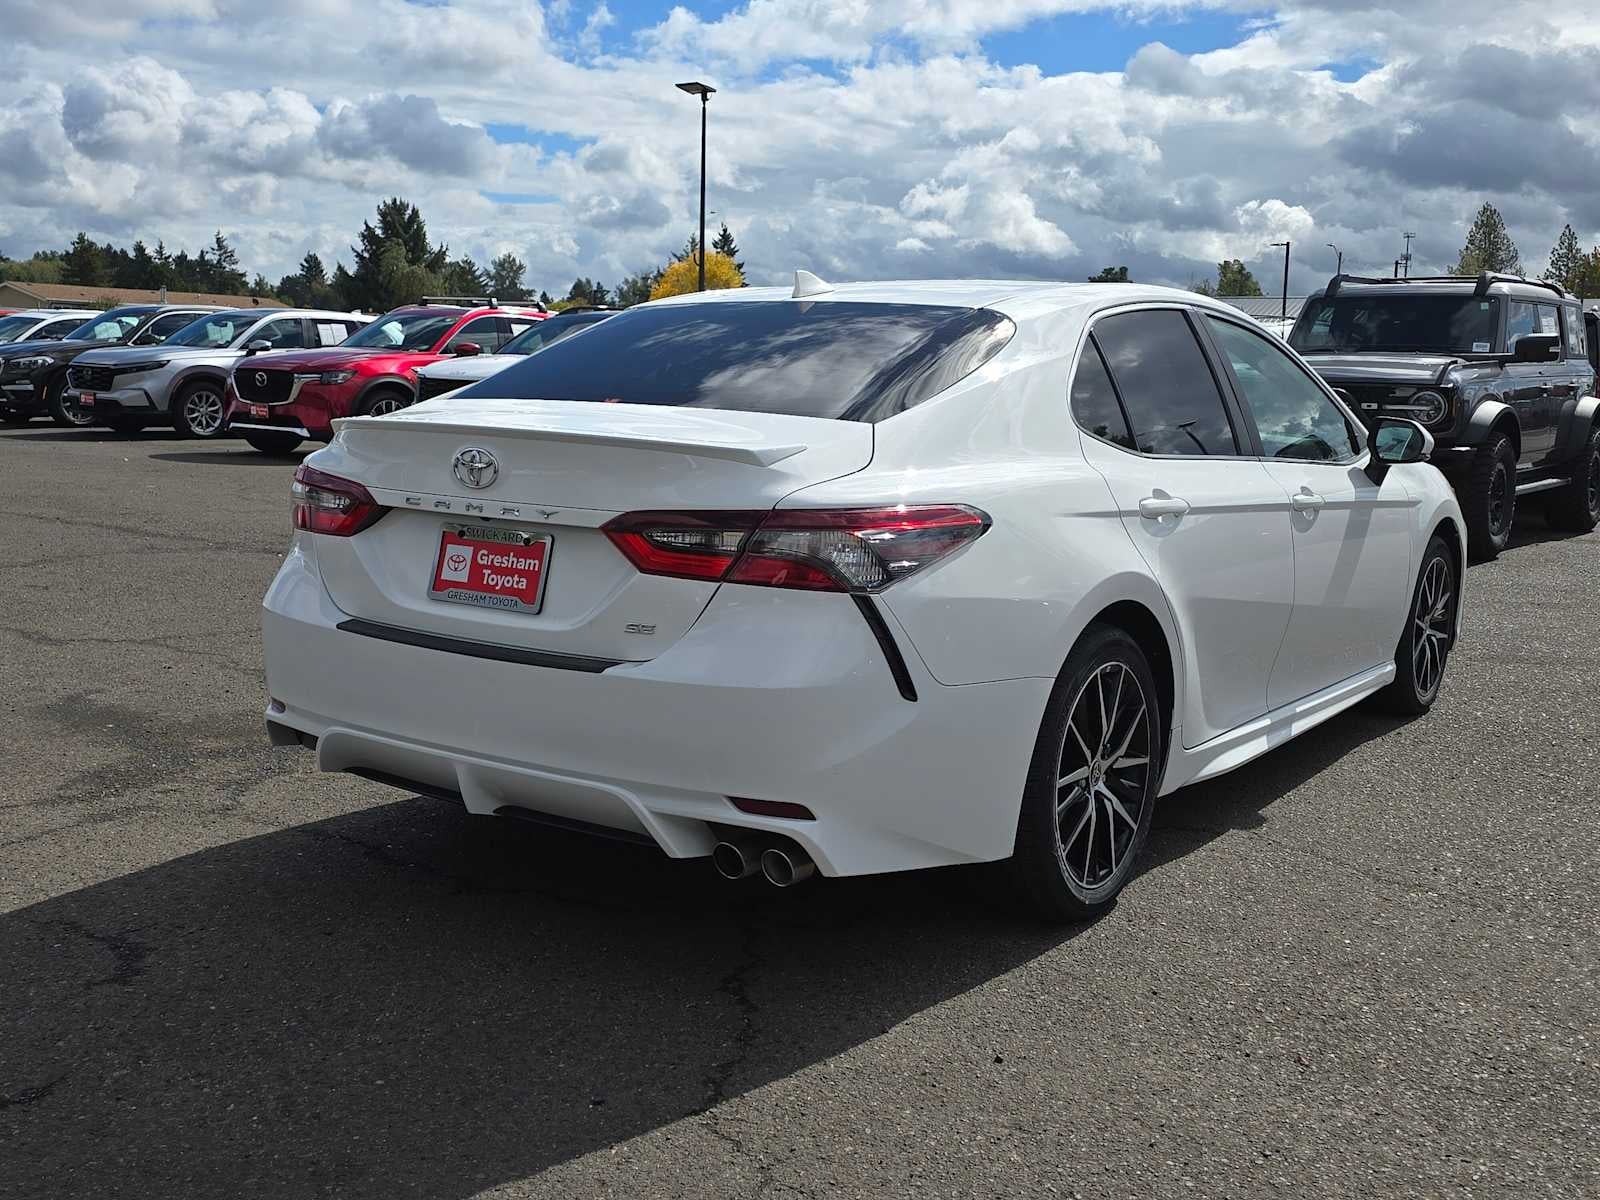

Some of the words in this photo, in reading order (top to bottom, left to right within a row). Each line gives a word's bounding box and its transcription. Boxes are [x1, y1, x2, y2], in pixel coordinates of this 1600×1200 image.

[405, 497, 560, 518] CAMRY
[466, 527, 523, 543] SWICKARD
[477, 549, 539, 571] Gresham
[483, 569, 527, 590] Toyota
[448, 591, 487, 606] GRESHAM
[488, 597, 518, 609] TOYOTA
